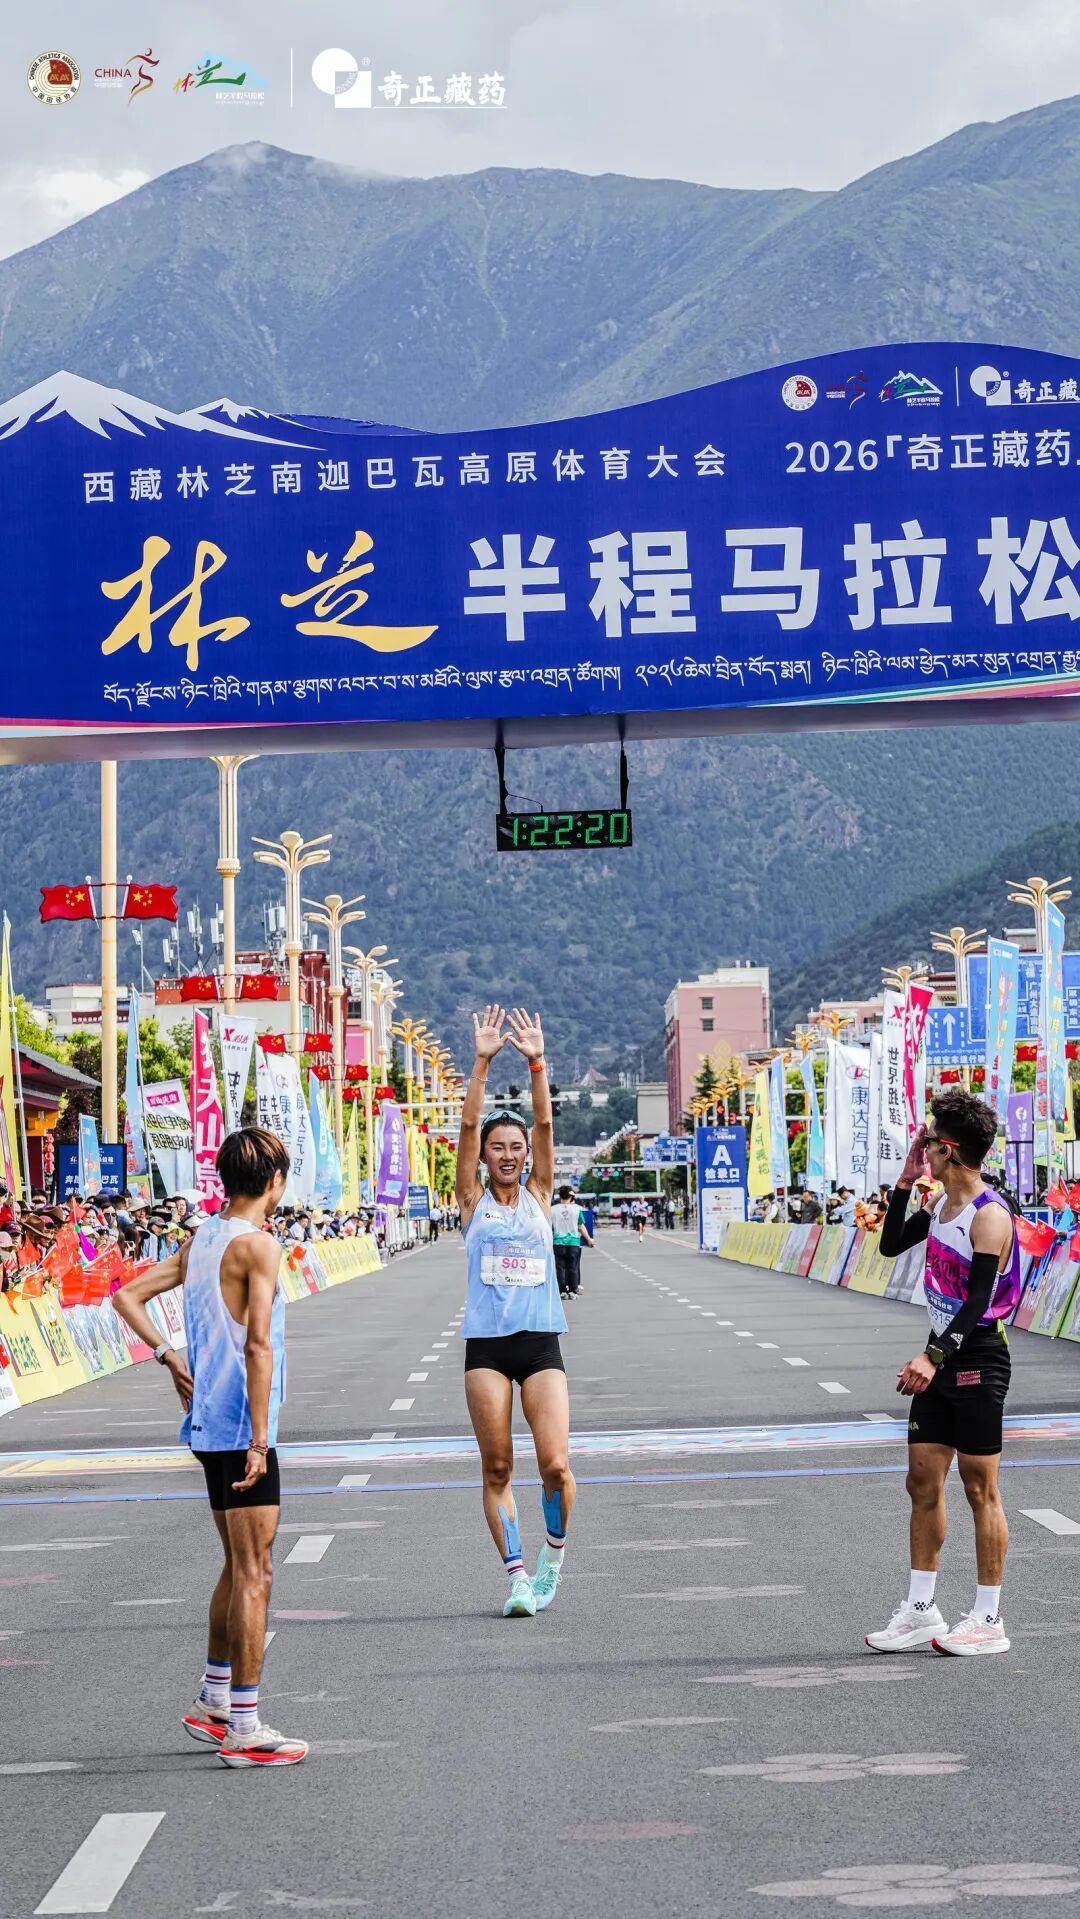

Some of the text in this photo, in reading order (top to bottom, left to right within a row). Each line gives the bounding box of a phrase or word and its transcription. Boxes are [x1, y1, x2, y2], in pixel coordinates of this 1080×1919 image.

[785, 428, 1080, 474] 2026「奇正藏药
[83, 442, 728, 505] 西藏林芝南迦巴瓦高原体育大会
[462, 515, 1080, 644] 半程马拉松
[513, 813, 628, 847] 1:22:20
[711, 1144, 733, 1166] A
[704, 1167, 740, 1179] 检录口
[502, 1257, 527, 1270] S03
